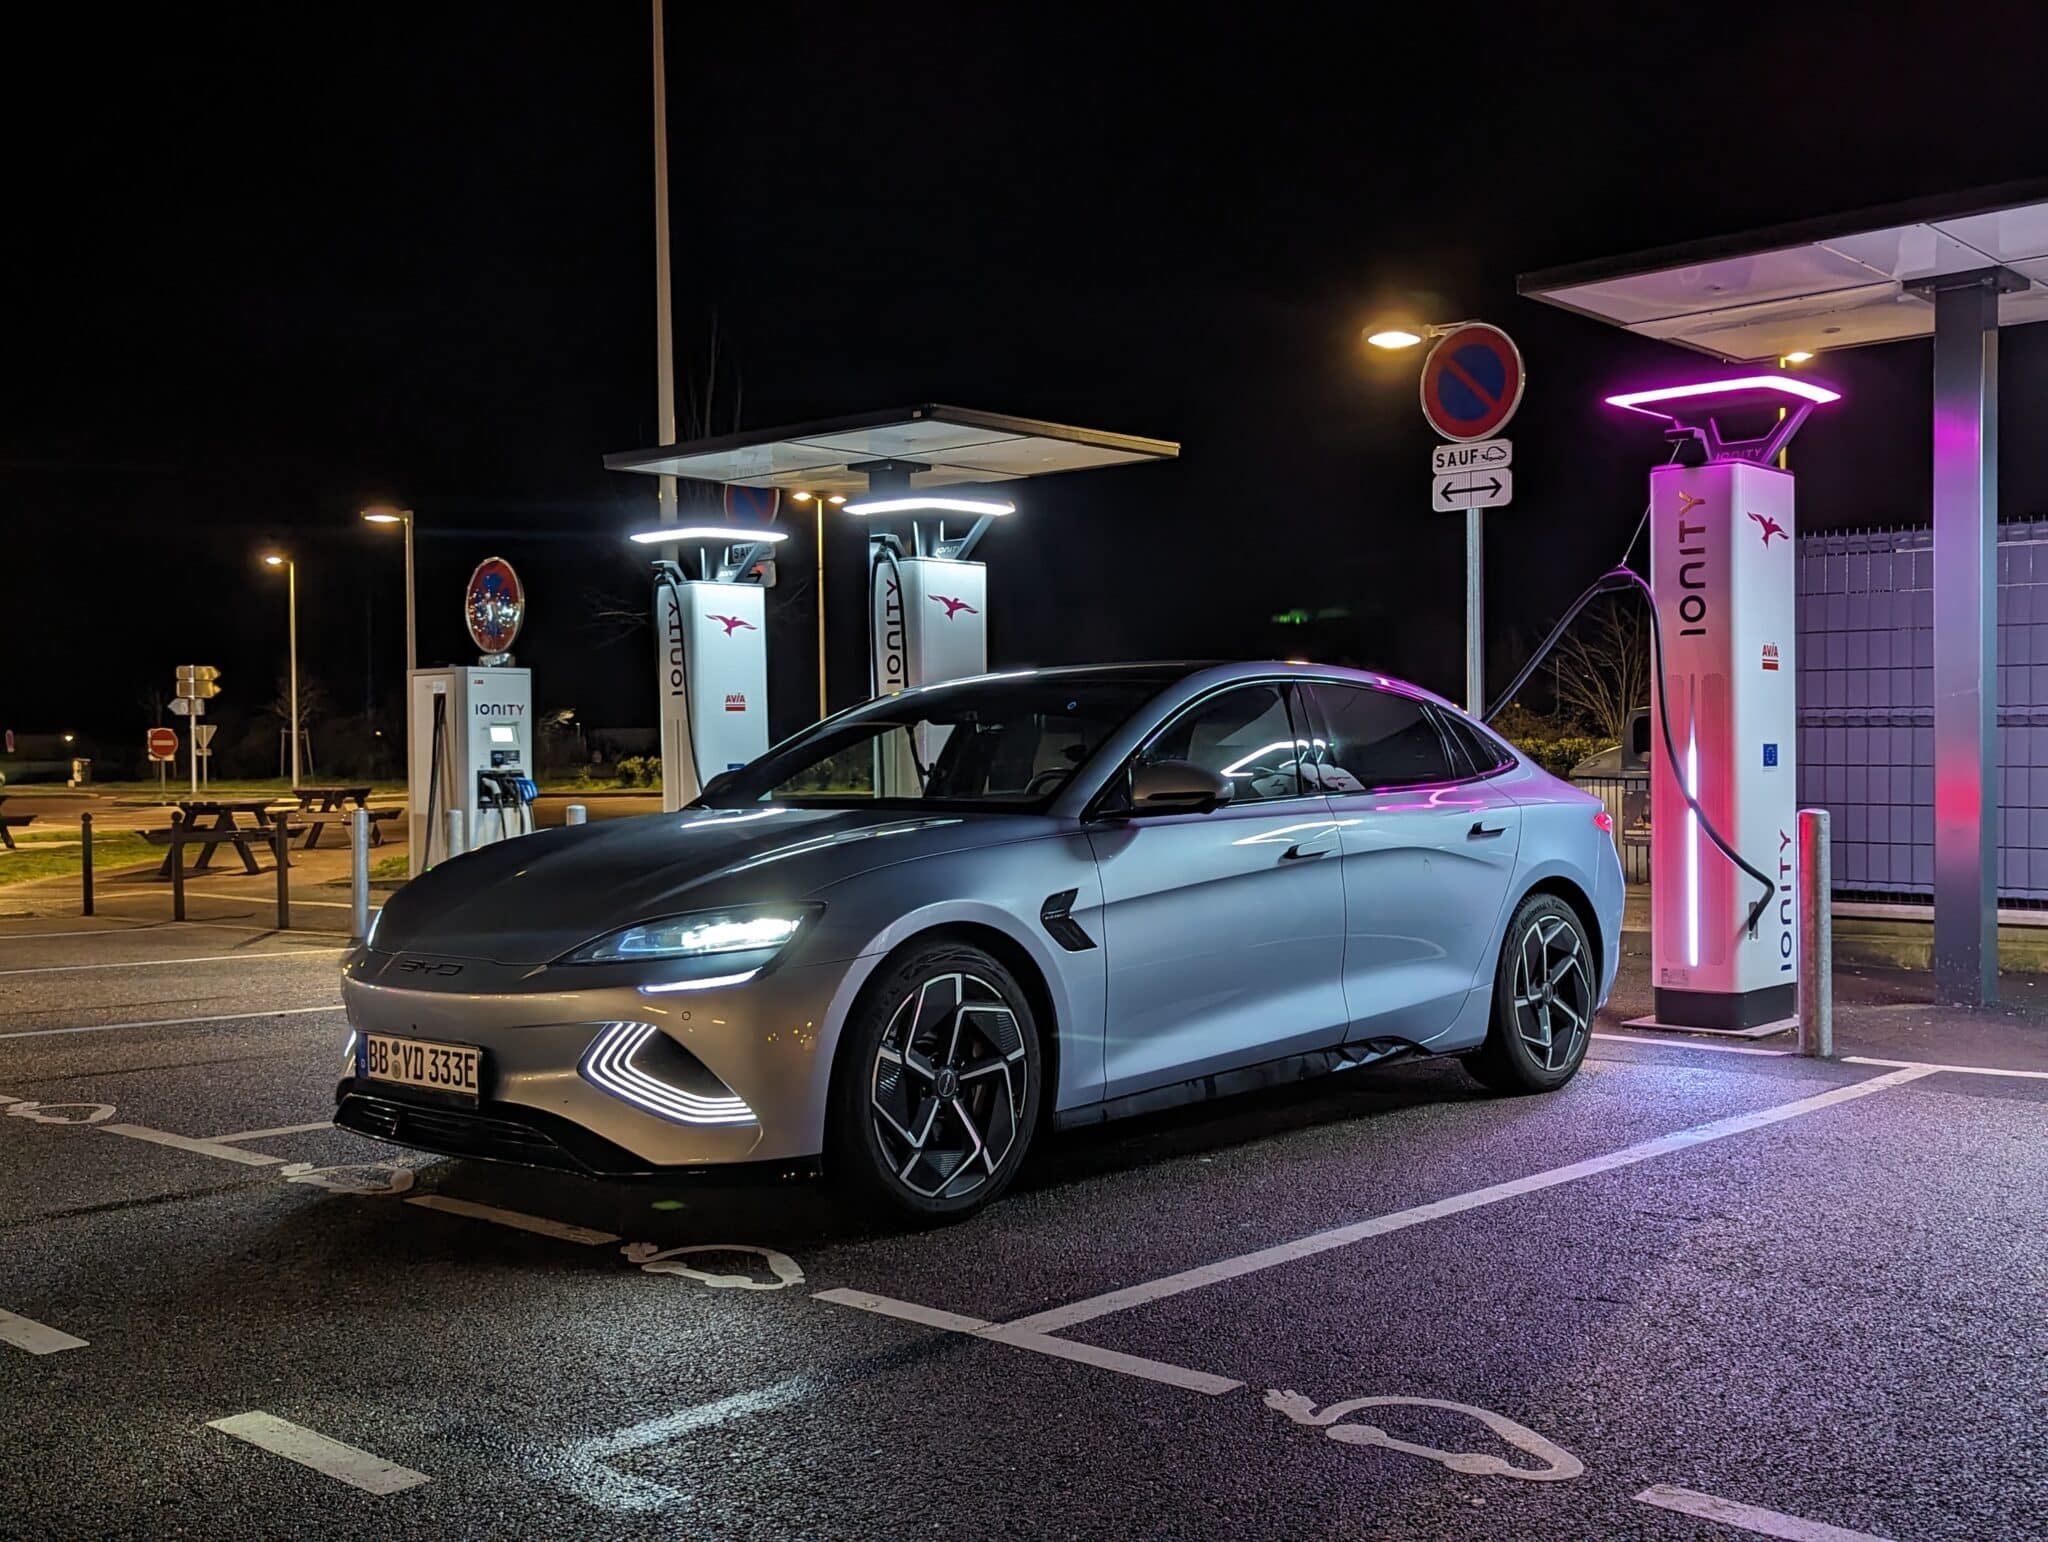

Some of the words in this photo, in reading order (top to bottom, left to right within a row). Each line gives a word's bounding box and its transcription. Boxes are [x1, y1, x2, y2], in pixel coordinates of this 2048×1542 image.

[1436, 449, 1479, 468] SAUF
[1678, 490, 1707, 636] IONITY
[668, 601, 684, 696] IONITY
[886, 579, 901, 684] IONITY
[475, 703, 525, 716] IONITY
[1780, 829, 1793, 971] IONITY
[400, 960, 464, 976] BYD
[369, 1039, 389, 1074] BB
[402, 1044, 424, 1081] YD
[428, 1048, 477, 1089] 333E
